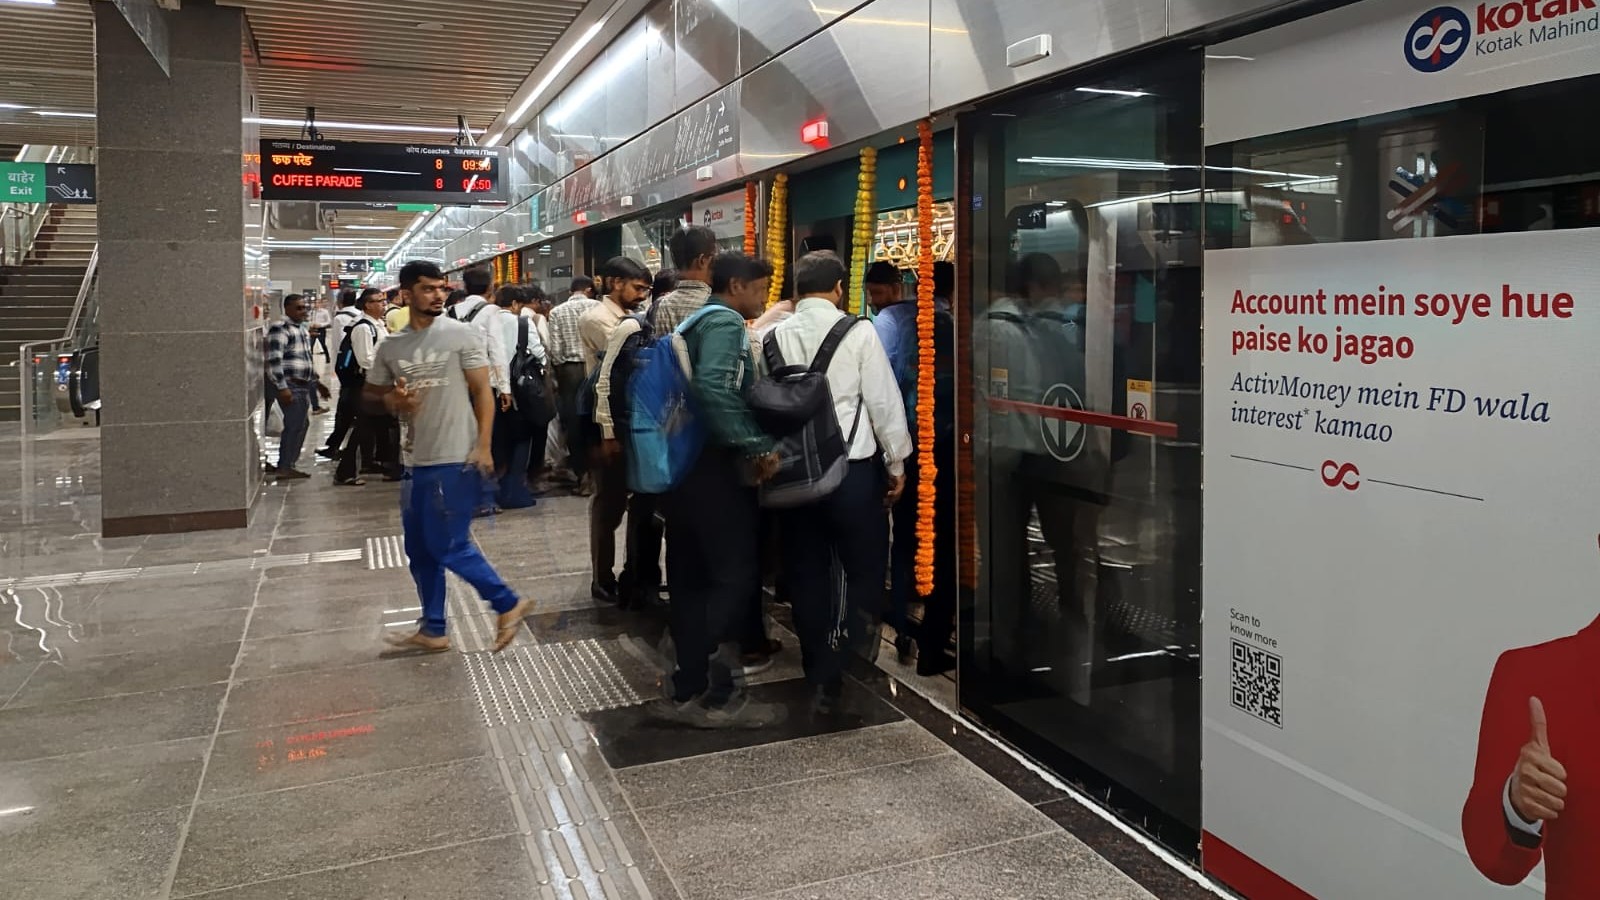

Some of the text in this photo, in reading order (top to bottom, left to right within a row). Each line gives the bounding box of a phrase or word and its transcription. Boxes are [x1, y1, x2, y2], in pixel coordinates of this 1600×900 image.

[1475, 11, 1599, 56] Kotak Mahind
[296, 143, 336, 151] Destination
[293, 152, 314, 166] परेड
[435, 158, 443, 171] 8
[8, 170, 35, 183] बाहेर
[272, 174, 313, 187] CUFFE
[315, 175, 363, 188] PARADE
[435, 178, 444, 190] 8
[10, 186, 32, 195] Exit
[1231, 284, 1574, 325] Account mein soye hue
[1232, 325, 1414, 365] paise ko jagao
[1230, 371, 1551, 423] ActivMoney mein FD wala
[1314, 411, 1393, 442] kamao
[1230, 607, 1261, 628] Scan to
[1230, 621, 1278, 649] know more
